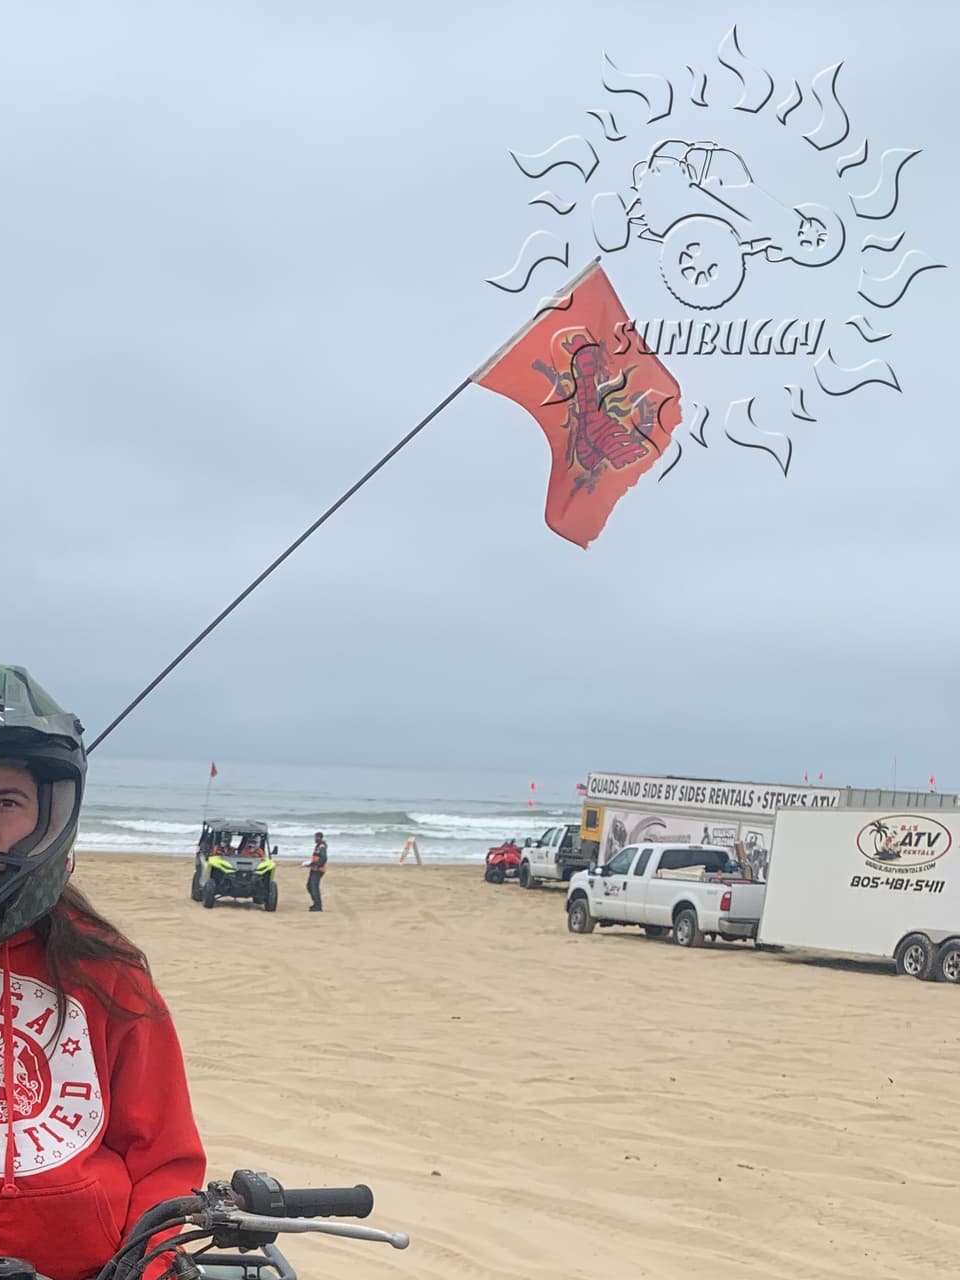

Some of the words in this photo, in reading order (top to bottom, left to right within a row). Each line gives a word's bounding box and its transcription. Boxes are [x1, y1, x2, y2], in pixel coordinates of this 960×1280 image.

[591, 777, 620, 795] QUADS
[620, 780, 640, 797] AND
[642, 782, 662, 799] SIDE
[664, 784, 678, 801] BY
[678, 785, 706, 804] SIDES
[708, 787, 755, 808] RENTALS
[900, 832, 941, 847] ATV
